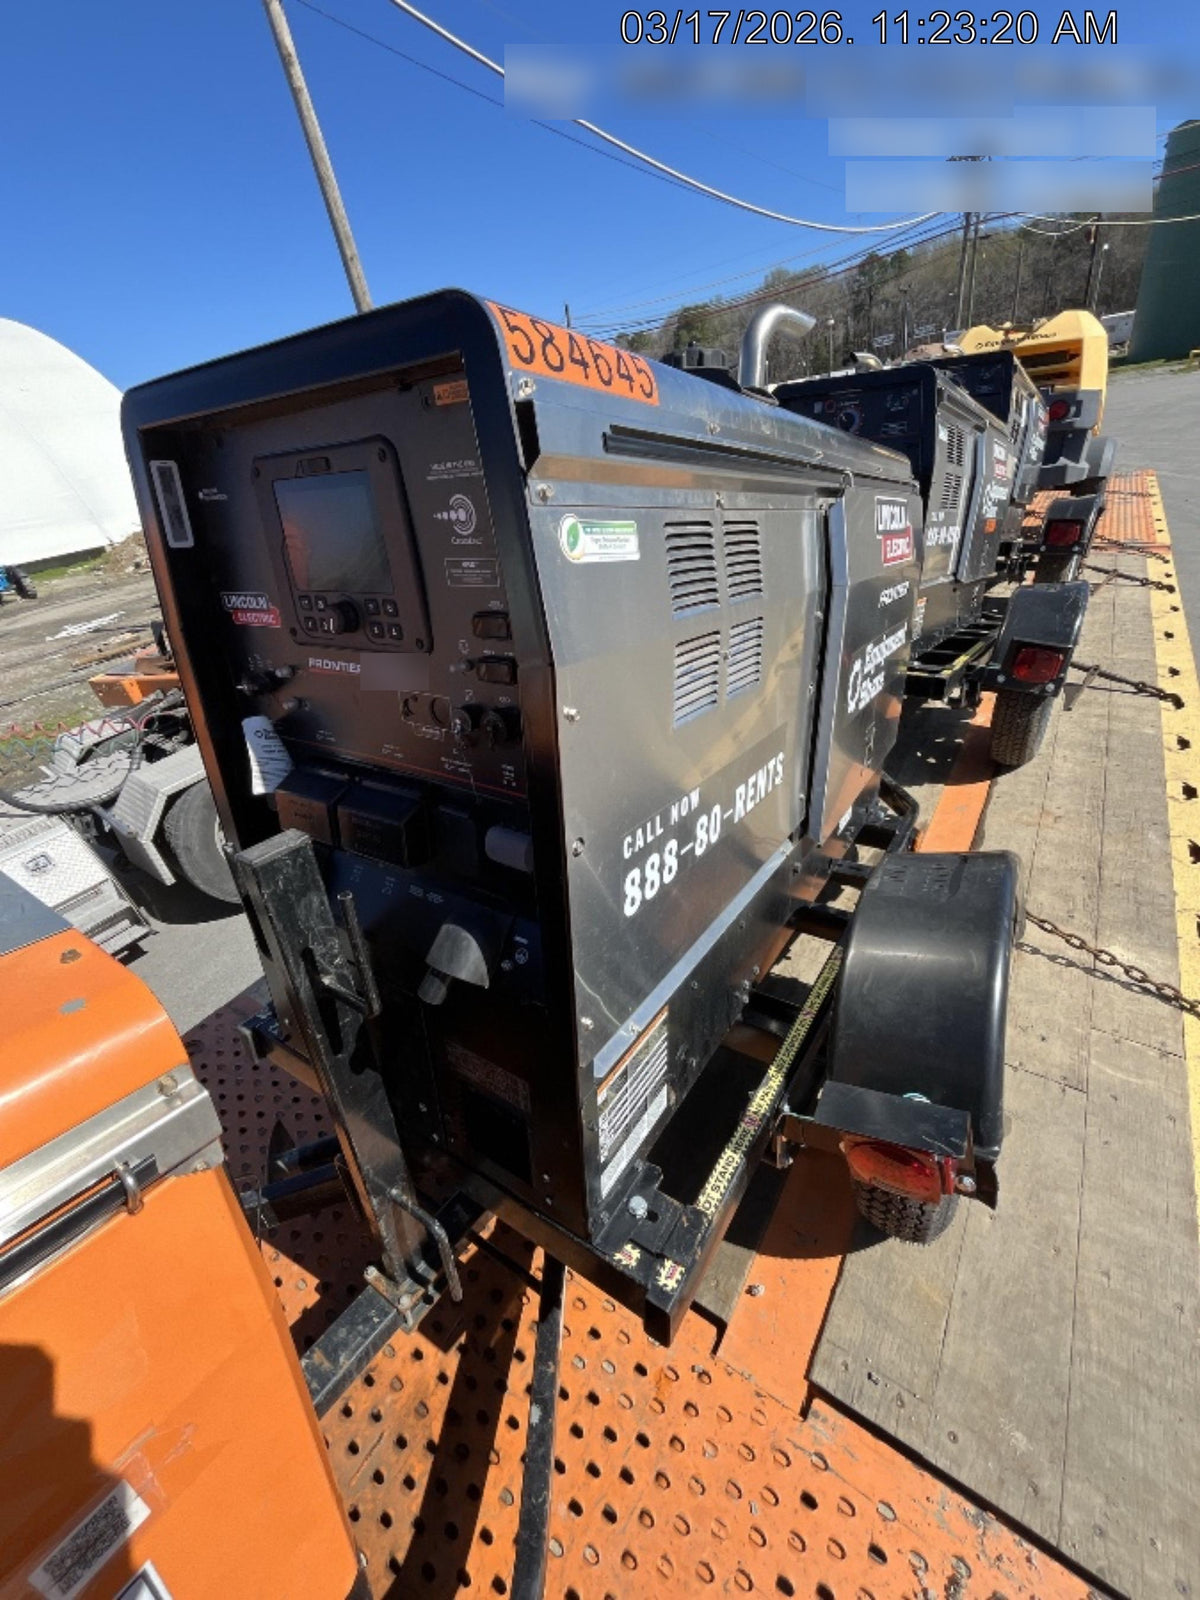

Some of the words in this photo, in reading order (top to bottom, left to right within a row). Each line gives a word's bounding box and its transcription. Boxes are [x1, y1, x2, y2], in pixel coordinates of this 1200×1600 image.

[497, 306, 654, 399] 584645
[223, 594, 268, 609] LINCOLN
[623, 814, 664, 860] CALL
[671, 786, 700, 826] NOW
[623, 751, 786, 918] 888-80-RENTS
[711, 1154, 735, 1191] STAND
